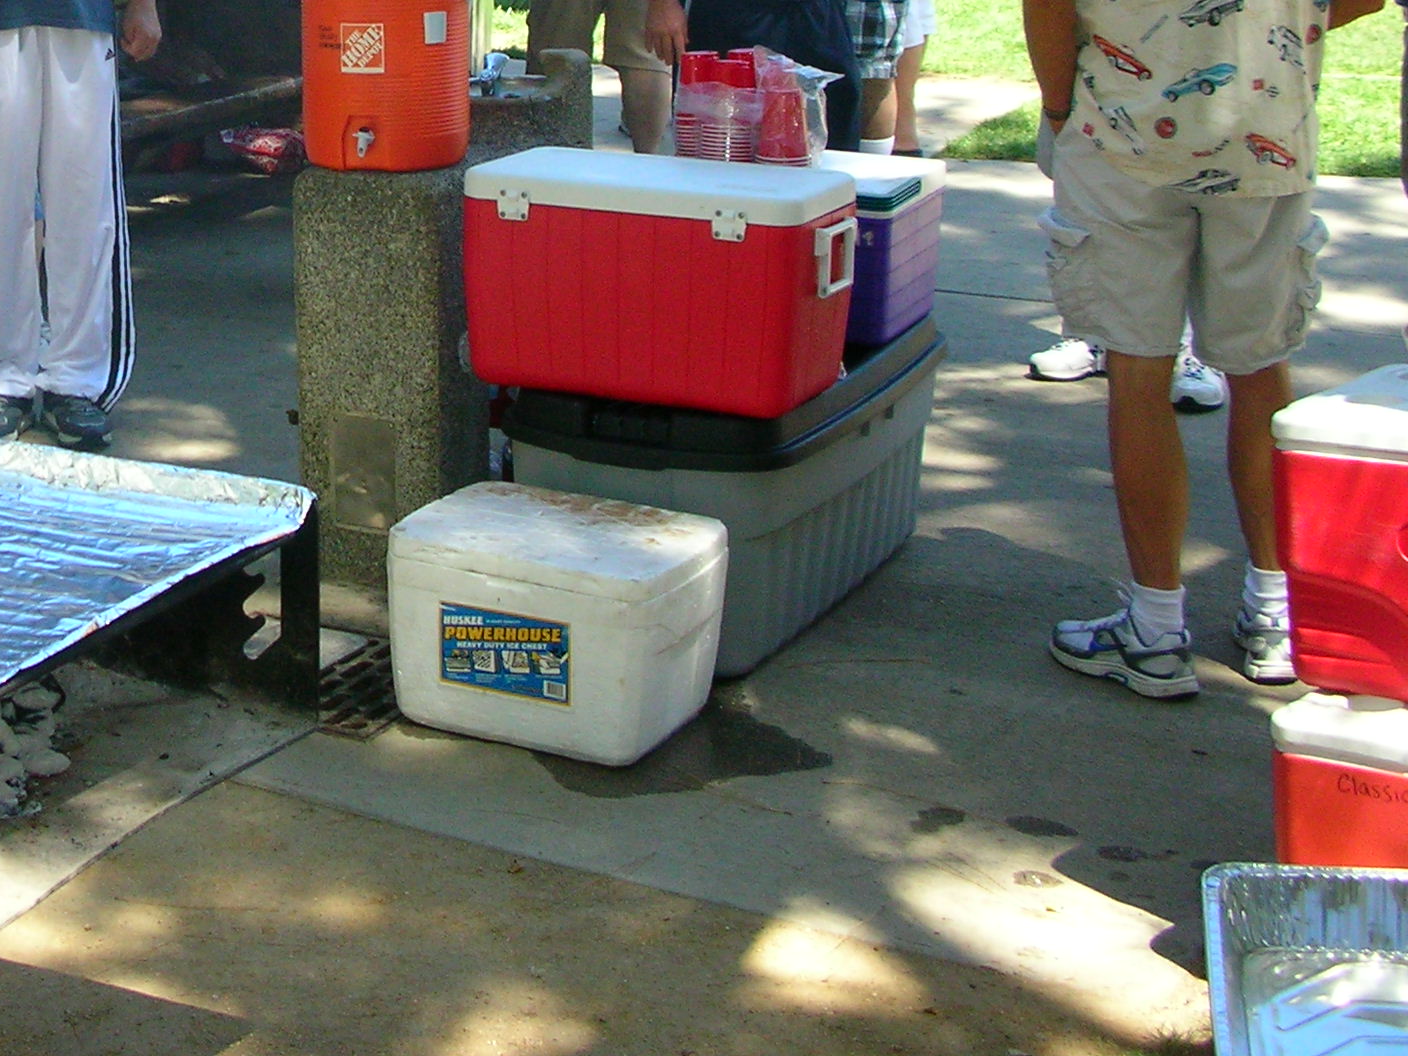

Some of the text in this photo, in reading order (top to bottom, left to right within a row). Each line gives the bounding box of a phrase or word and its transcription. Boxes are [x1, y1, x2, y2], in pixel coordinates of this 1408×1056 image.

[341, 24, 383, 67] HOME
[357, 42, 382, 67] DEPOT
[443, 615, 484, 625] HUSKEE
[444, 626, 561, 642] POWERHOUSE
